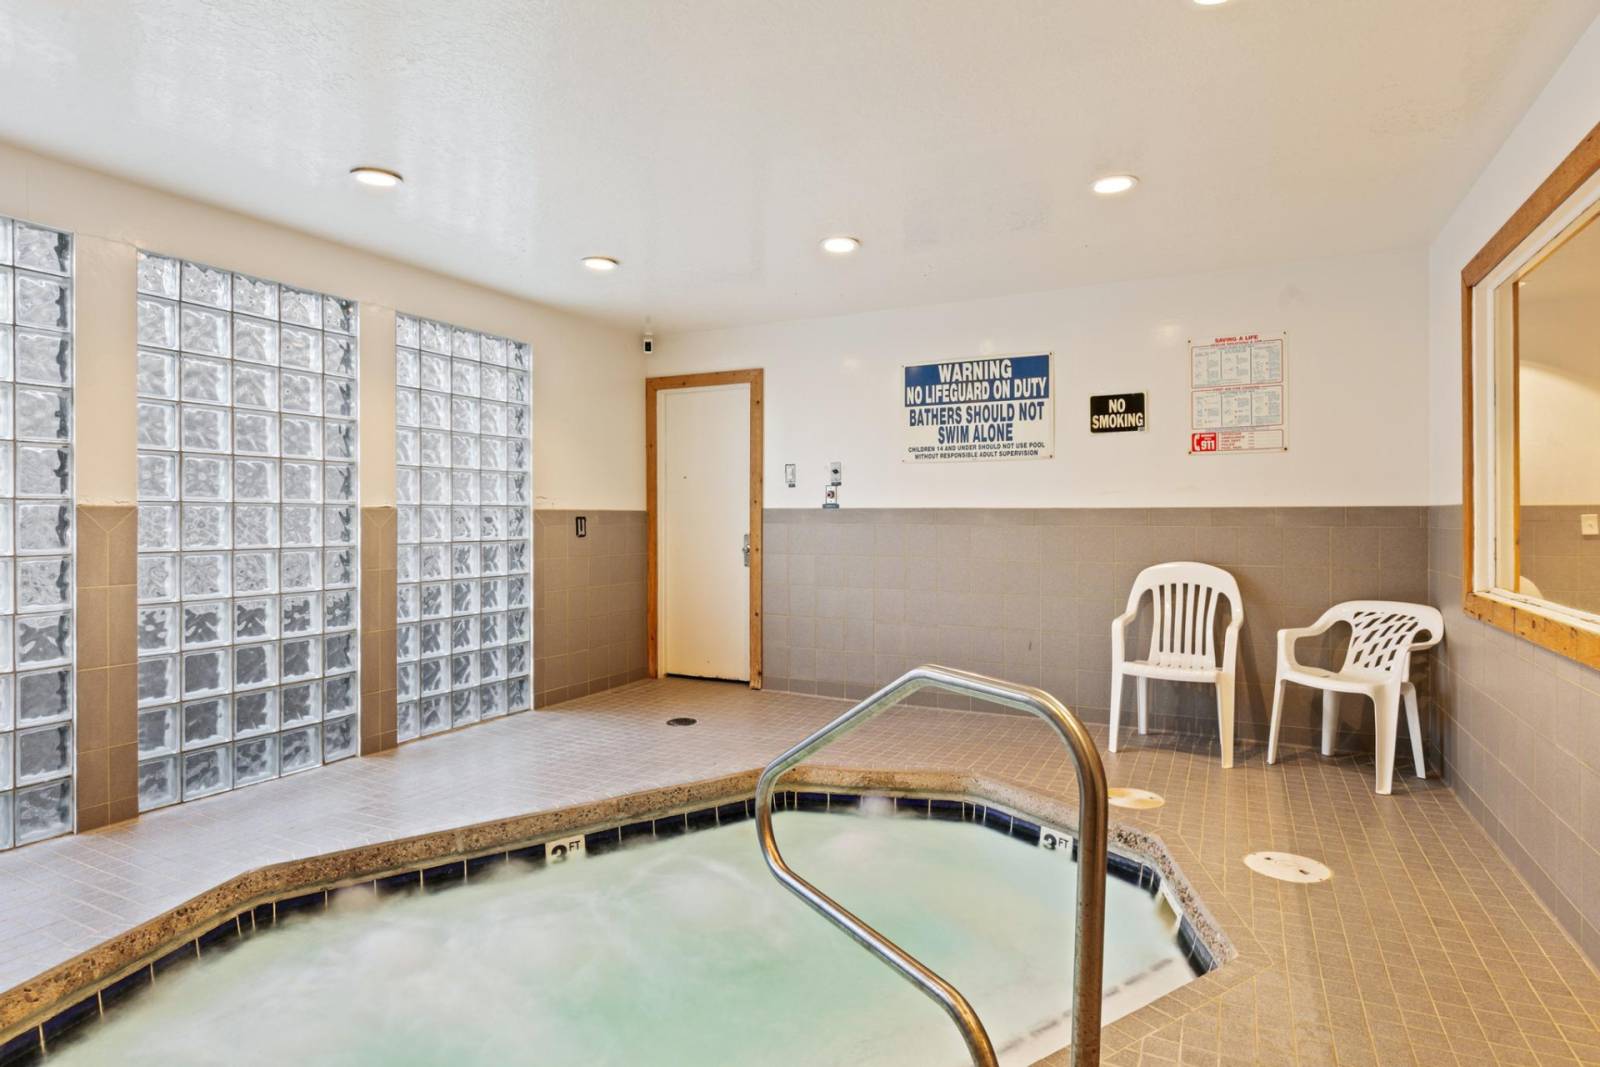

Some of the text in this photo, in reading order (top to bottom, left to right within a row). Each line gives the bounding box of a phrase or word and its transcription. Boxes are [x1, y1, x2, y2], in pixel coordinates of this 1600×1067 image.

[938, 359, 1012, 383] WARNING
[906, 376, 1047, 405] NO LIFEGUARD ON DUTY
[909, 401, 1045, 426] BATHERS SHOULD NOT
[1109, 398, 1125, 413] NO
[1092, 413, 1143, 429] SMOKING
[938, 423, 1013, 444] SWIM ALONE
[1029, 441, 1045, 449] POOL
[980, 450, 997, 458] ADULT
[999, 449, 1039, 457] SUPERVISION
[569, 840, 580, 851] FT
[1043, 833, 1069, 850] 3 FT
